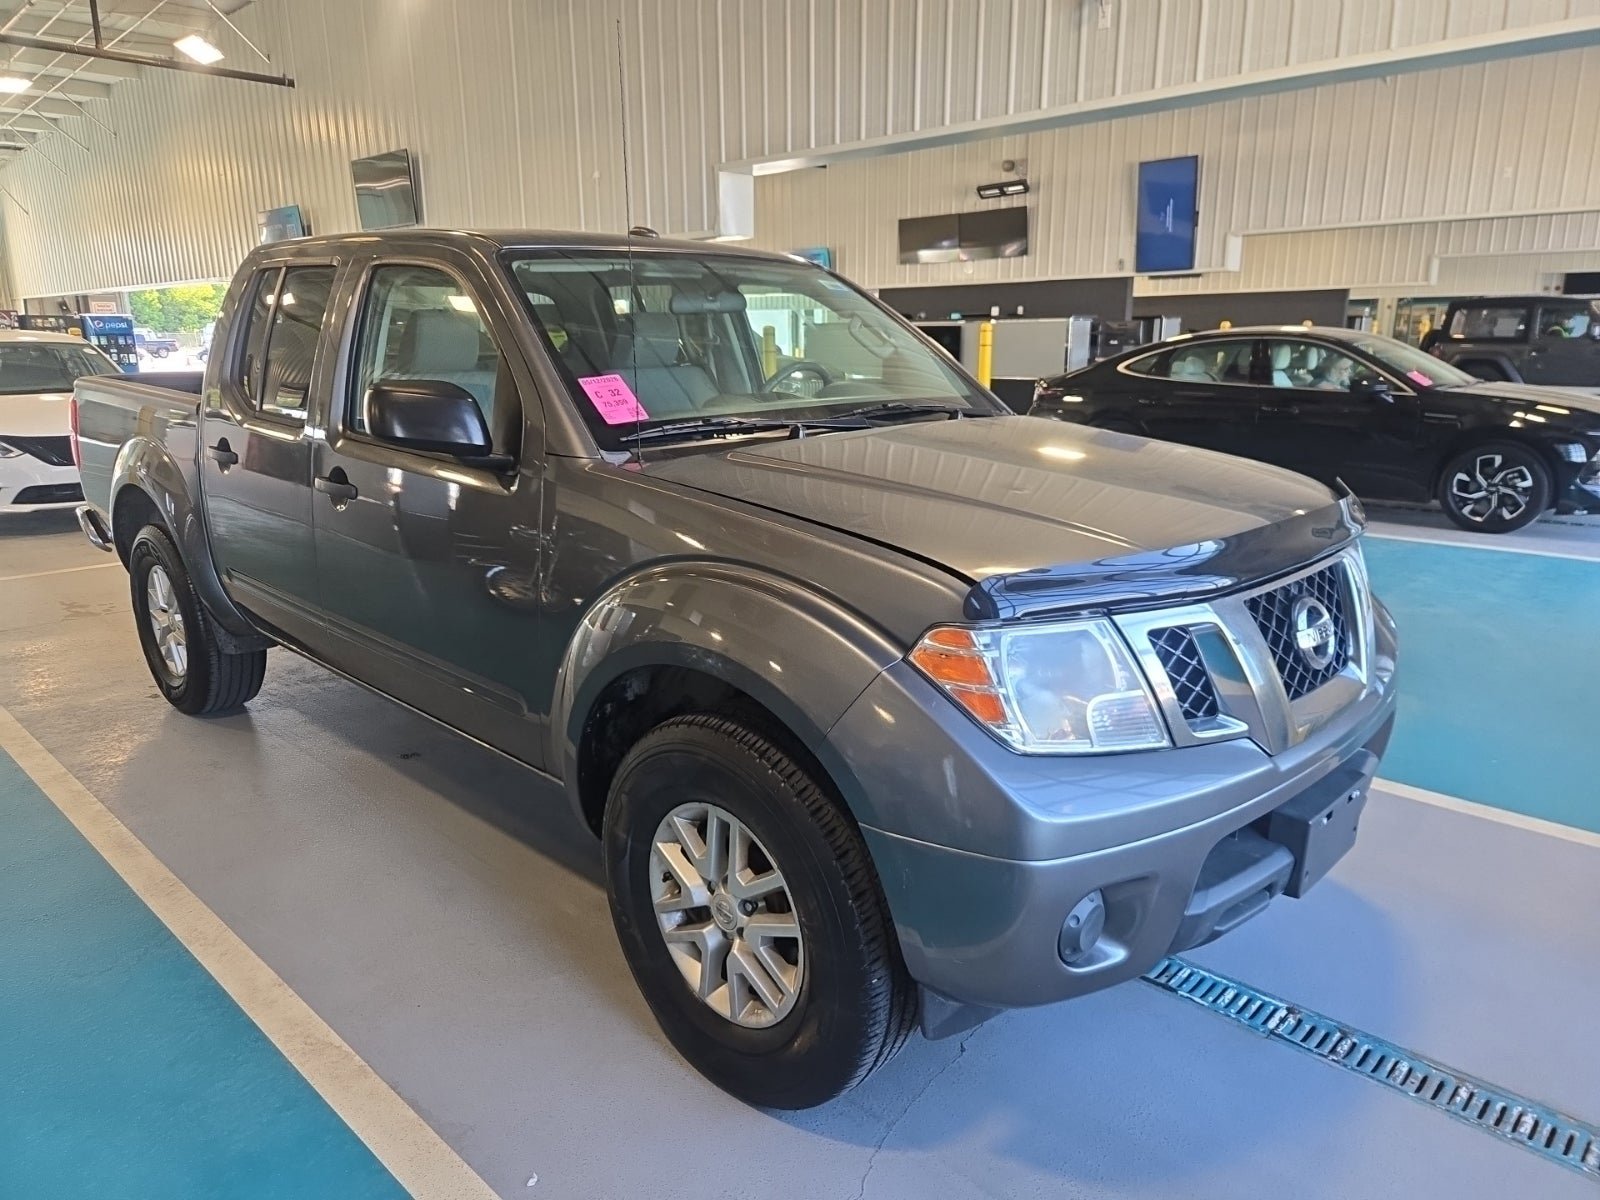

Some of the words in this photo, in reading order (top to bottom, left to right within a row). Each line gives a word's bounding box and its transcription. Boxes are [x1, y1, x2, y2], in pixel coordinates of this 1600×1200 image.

[105, 321, 128, 331] pepsi
[594, 391, 603, 399] C
[608, 388, 622, 397] 32
